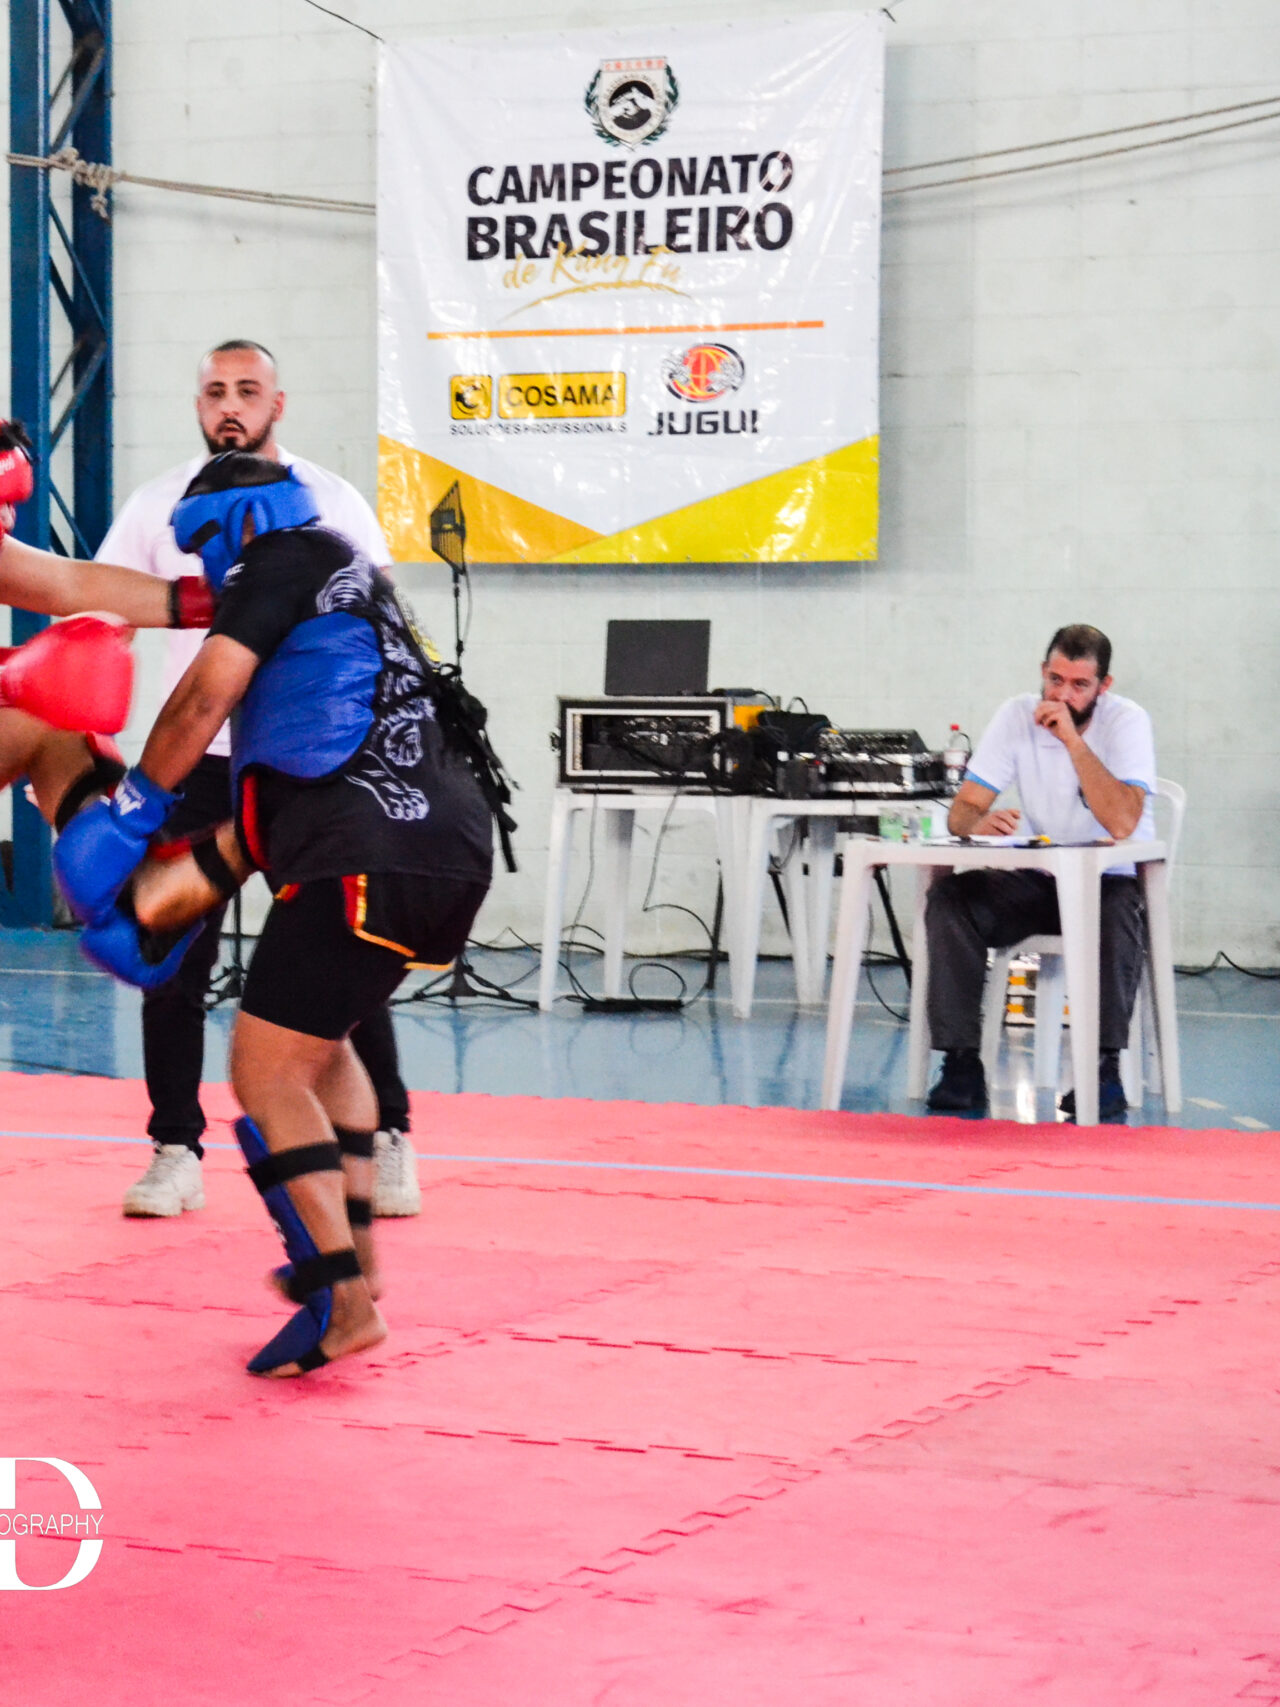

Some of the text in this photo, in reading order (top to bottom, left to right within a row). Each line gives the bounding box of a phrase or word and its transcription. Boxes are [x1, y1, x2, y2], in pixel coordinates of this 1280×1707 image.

[467, 151, 793, 206] CAMPEONATO
[467, 202, 793, 260] BRASILEIRO
[503, 253, 537, 289] de
[551, 241, 630, 284] Kung
[506, 384, 618, 407] COSAMA
[648, 409, 758, 435] JUGUI
